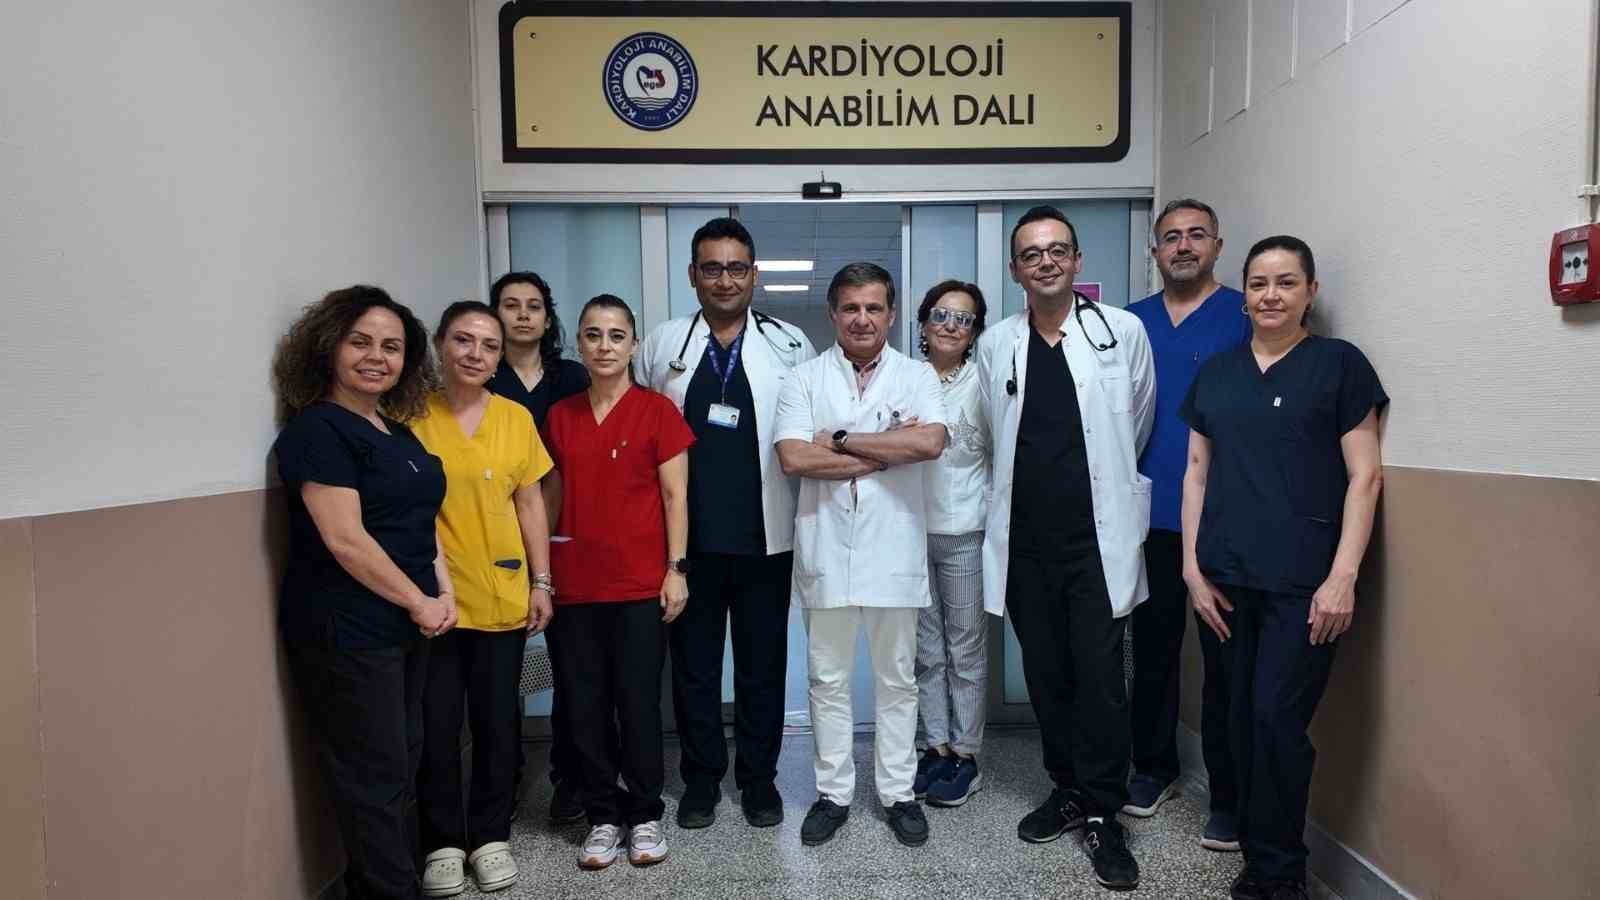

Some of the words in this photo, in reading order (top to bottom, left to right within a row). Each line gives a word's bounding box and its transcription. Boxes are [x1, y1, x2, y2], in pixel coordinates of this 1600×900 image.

[757, 38, 1004, 77] KARDİYOLOJİ
[666, 93, 688, 119] DALI
[755, 88, 940, 127] ANABİLİM
[953, 93, 1034, 126] DALI
